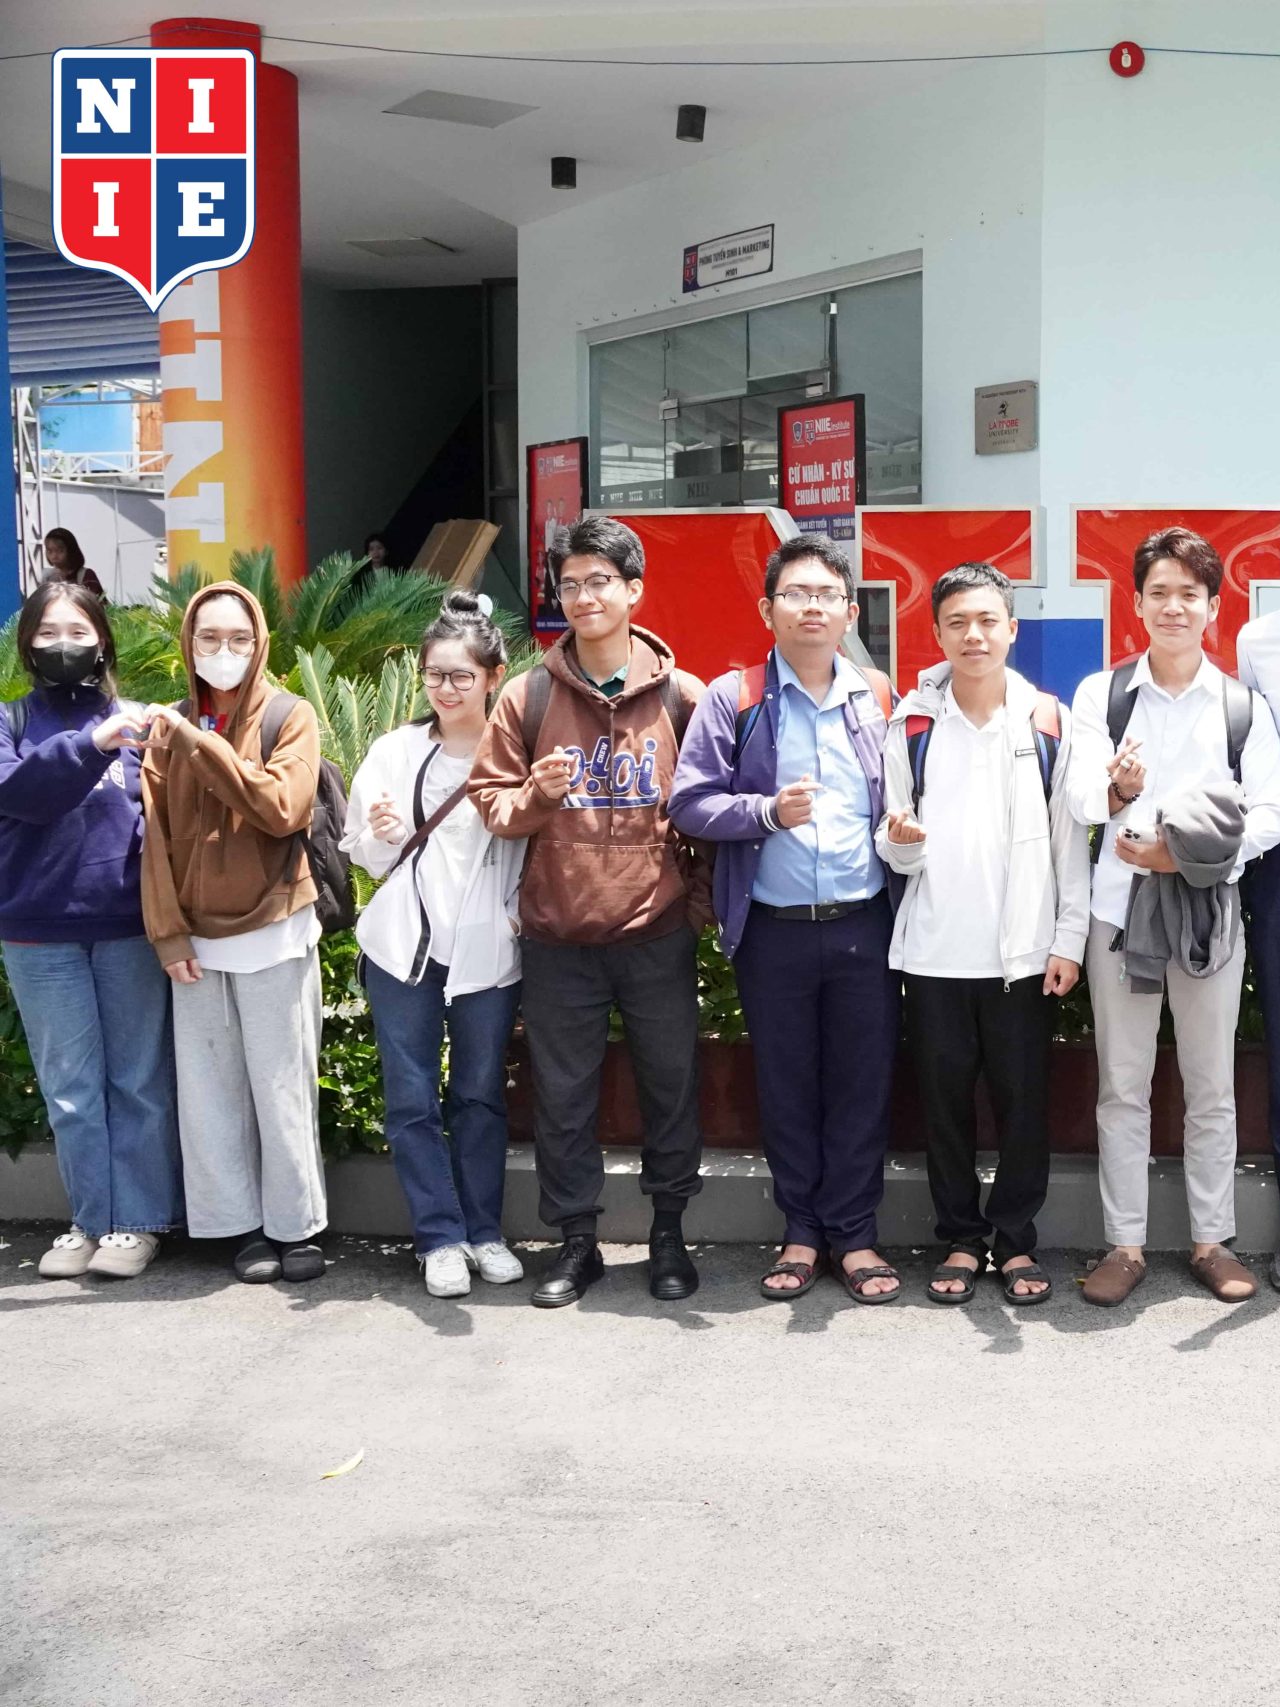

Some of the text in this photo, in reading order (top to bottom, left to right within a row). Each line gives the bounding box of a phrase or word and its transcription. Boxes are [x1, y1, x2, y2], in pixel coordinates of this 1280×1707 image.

[742, 239, 770, 253] MARKETING
[815, 417, 831, 433] NIIE
[802, 461, 825, 483] NHÂN
